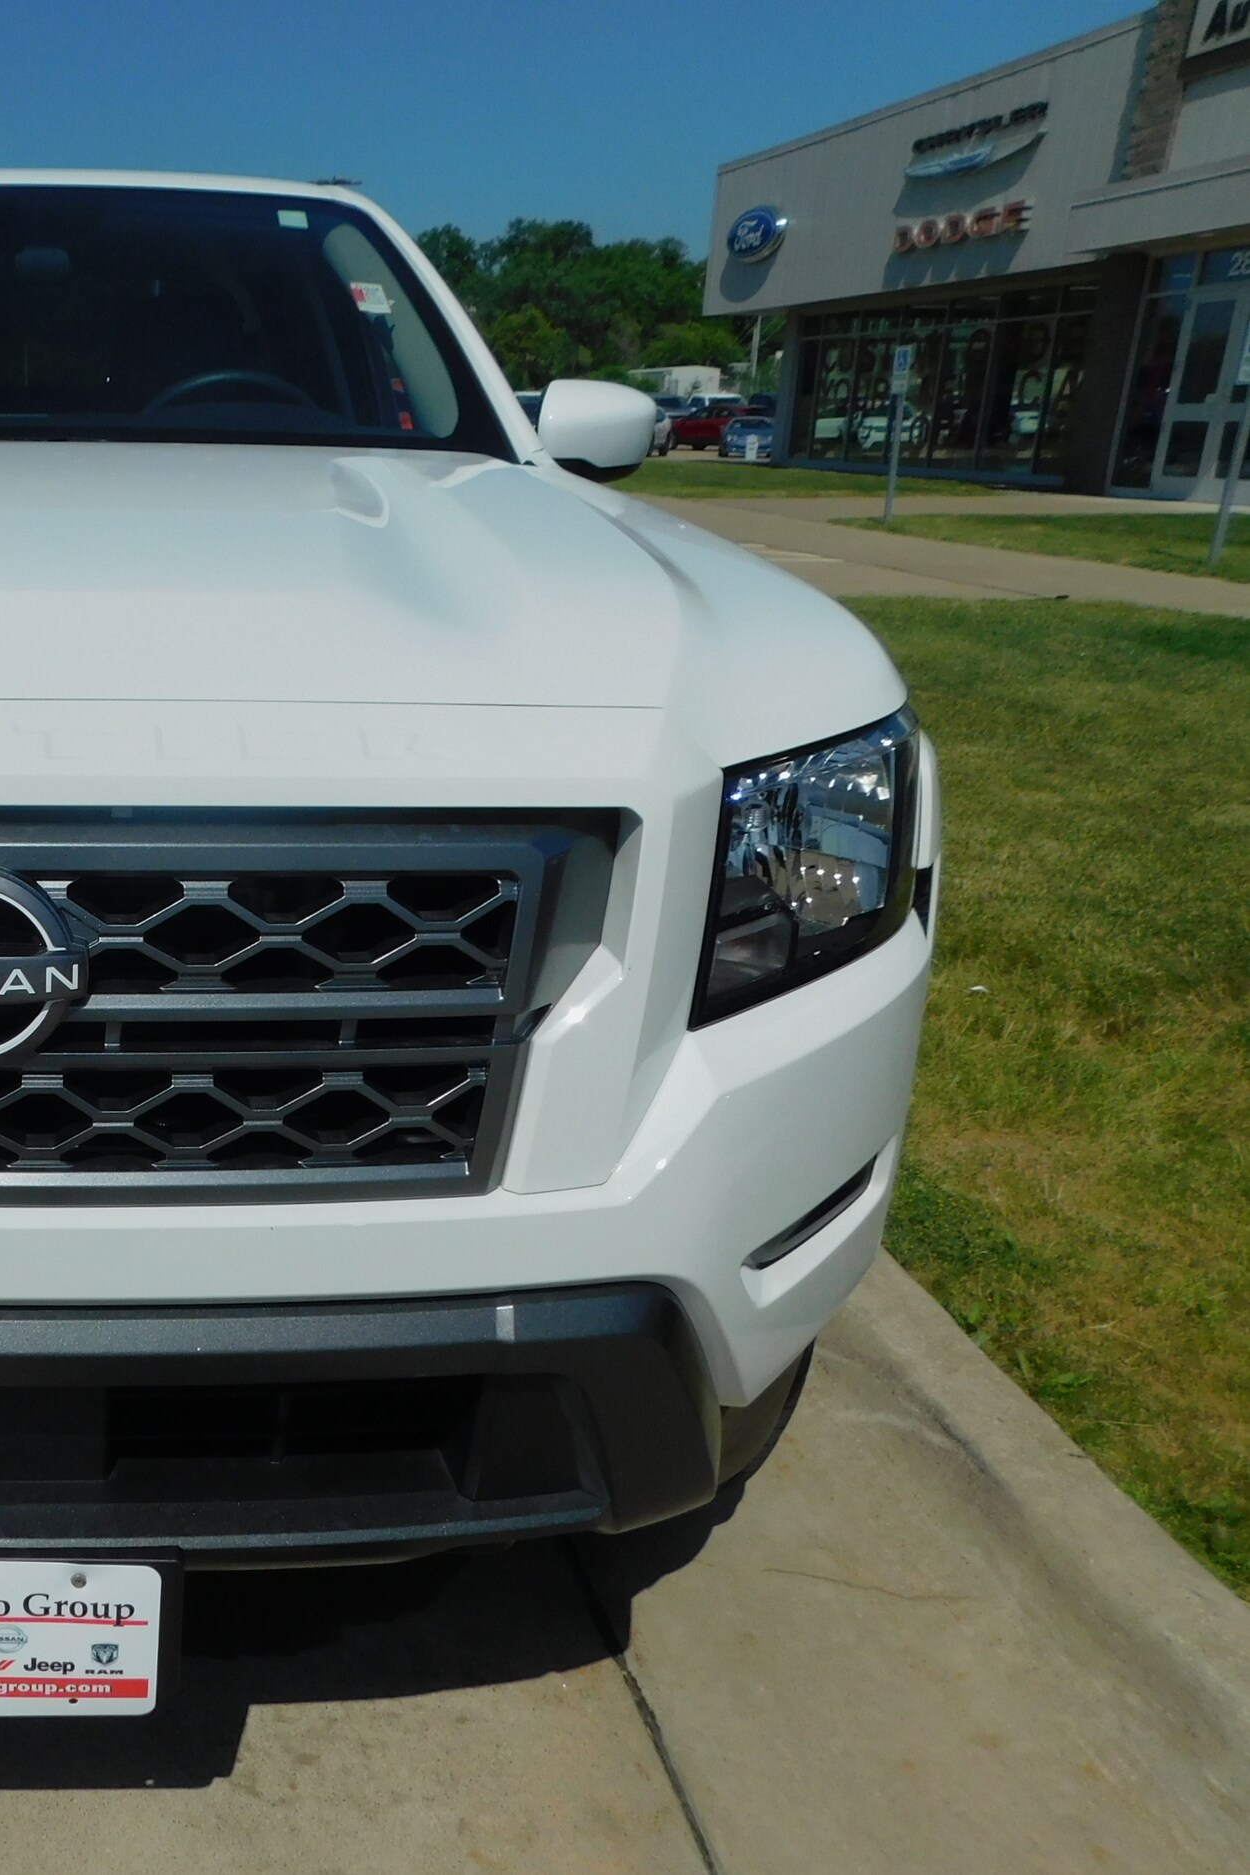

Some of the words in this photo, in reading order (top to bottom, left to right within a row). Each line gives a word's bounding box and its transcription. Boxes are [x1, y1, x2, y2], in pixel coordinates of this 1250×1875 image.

[733, 219, 765, 252] Ford
[893, 199, 1034, 253] DODGE
[22, 1594, 136, 1627] Group
[23, 1658, 76, 1675] Jeep
